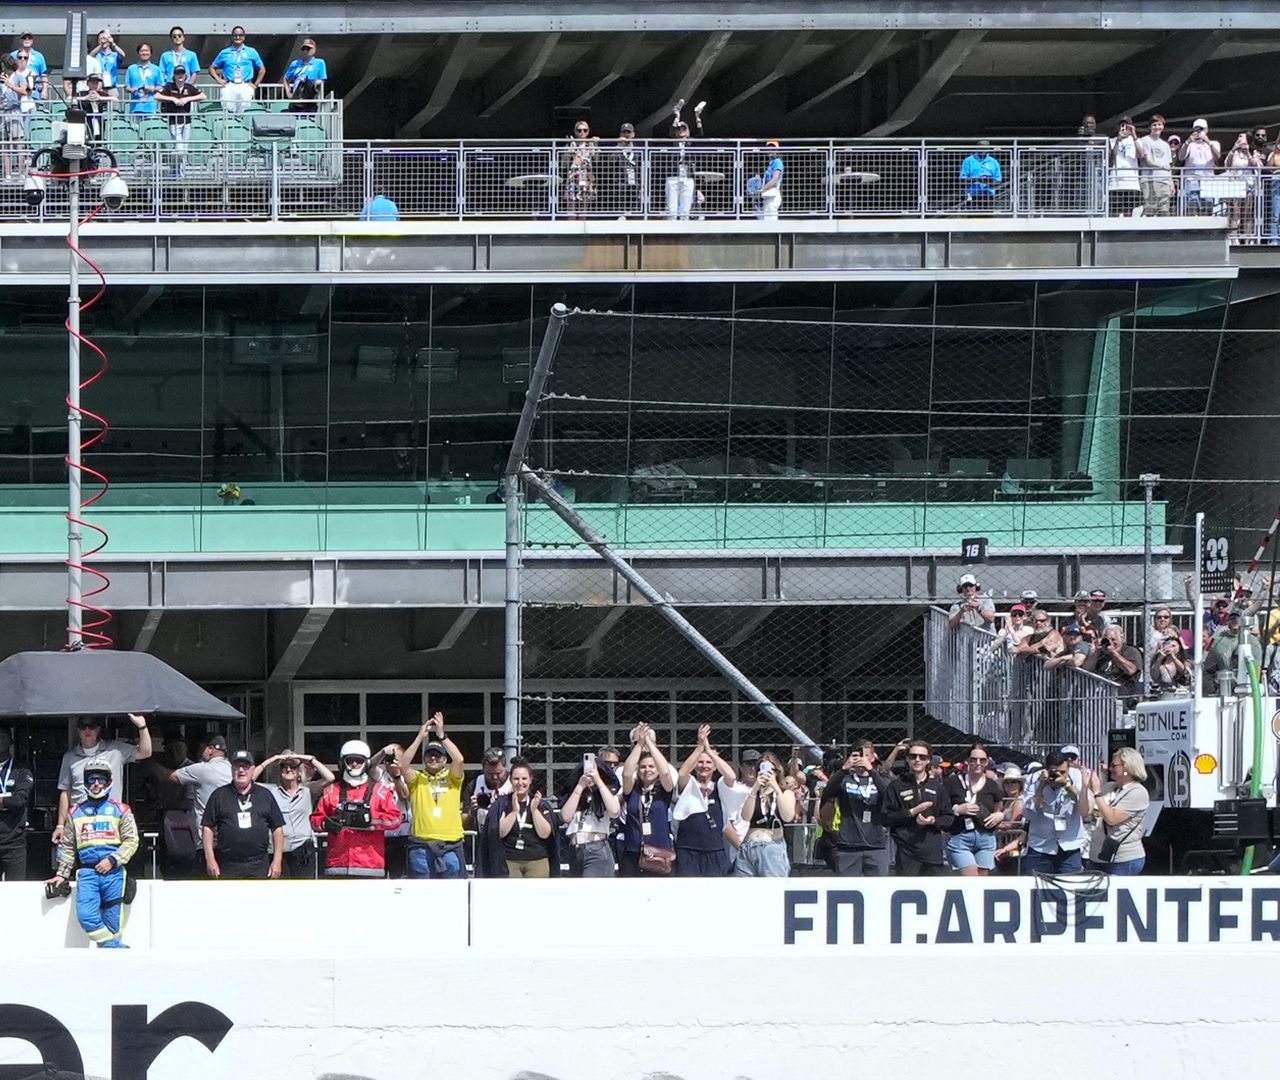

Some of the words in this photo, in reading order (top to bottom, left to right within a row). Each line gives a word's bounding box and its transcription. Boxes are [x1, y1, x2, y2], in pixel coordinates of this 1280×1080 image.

[965, 543, 980, 557] 16
[1206, 536, 1228, 572] 33
[1138, 710, 1188, 732] BITNILE
[1170, 732, 1188, 741] COM
